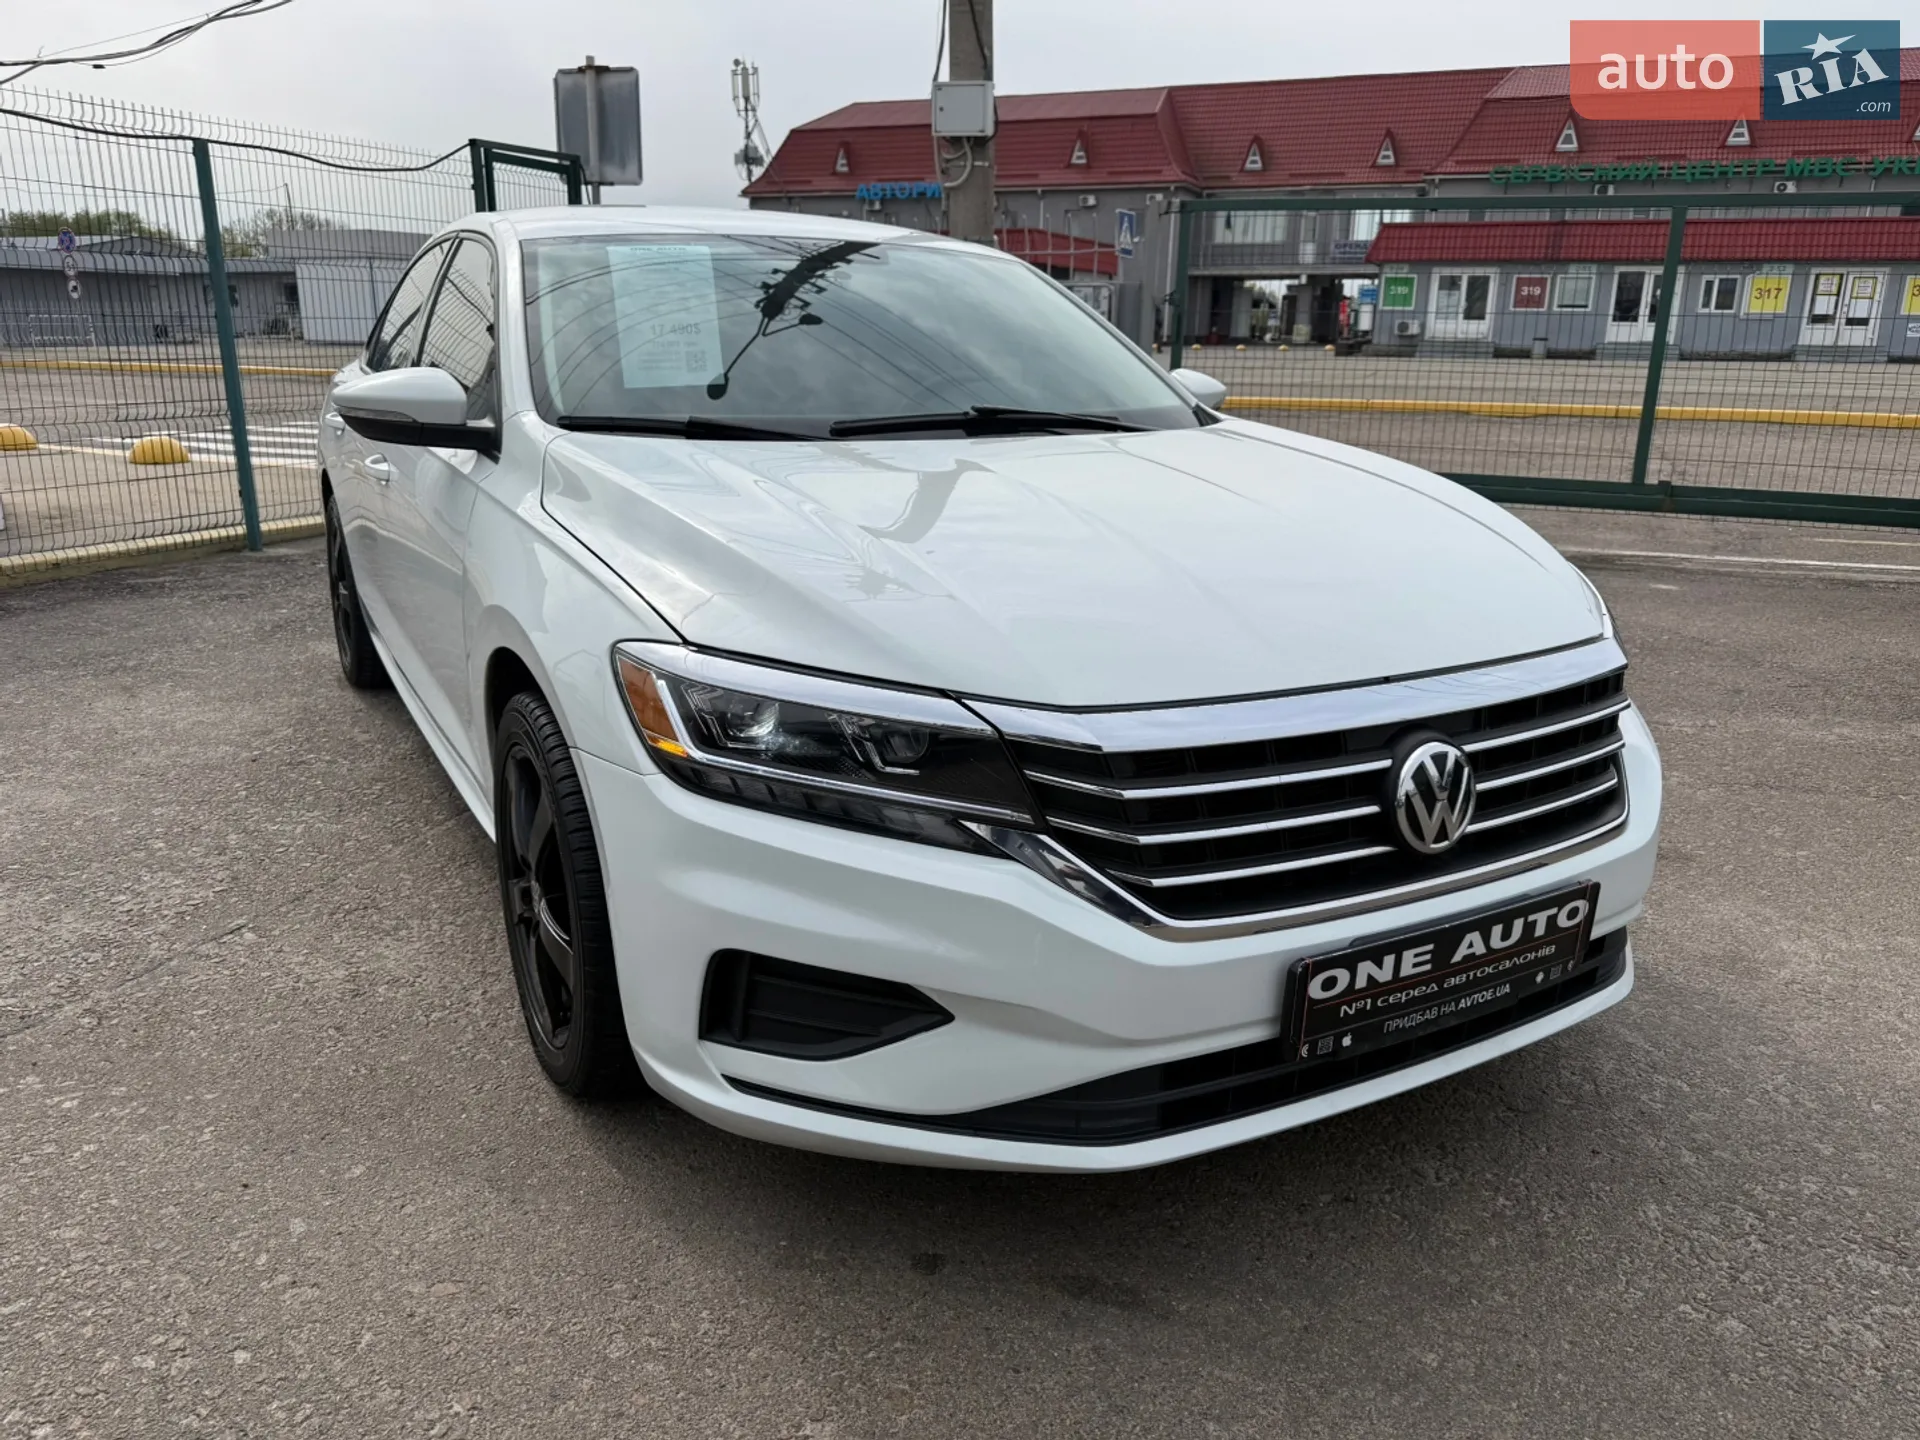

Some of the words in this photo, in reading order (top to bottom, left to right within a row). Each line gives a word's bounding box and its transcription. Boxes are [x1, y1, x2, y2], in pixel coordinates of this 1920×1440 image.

[1670, 157, 1777, 183] ЦЕНТР
[1783, 155, 1859, 178] МВС
[1520, 285, 1541, 295] 319
[1754, 287, 1783, 300] 317
[1307, 943, 1435, 1001] ONE
[1450, 899, 1590, 964] AUTO
[1377, 981, 1441, 1008] серед
[1443, 944, 1556, 989] автосалонів
[1383, 1007, 1439, 1034] ПРИДБАВ
[1440, 1000, 1457, 1015] НА
[1457, 982, 1511, 1011] AVTOE.UA
